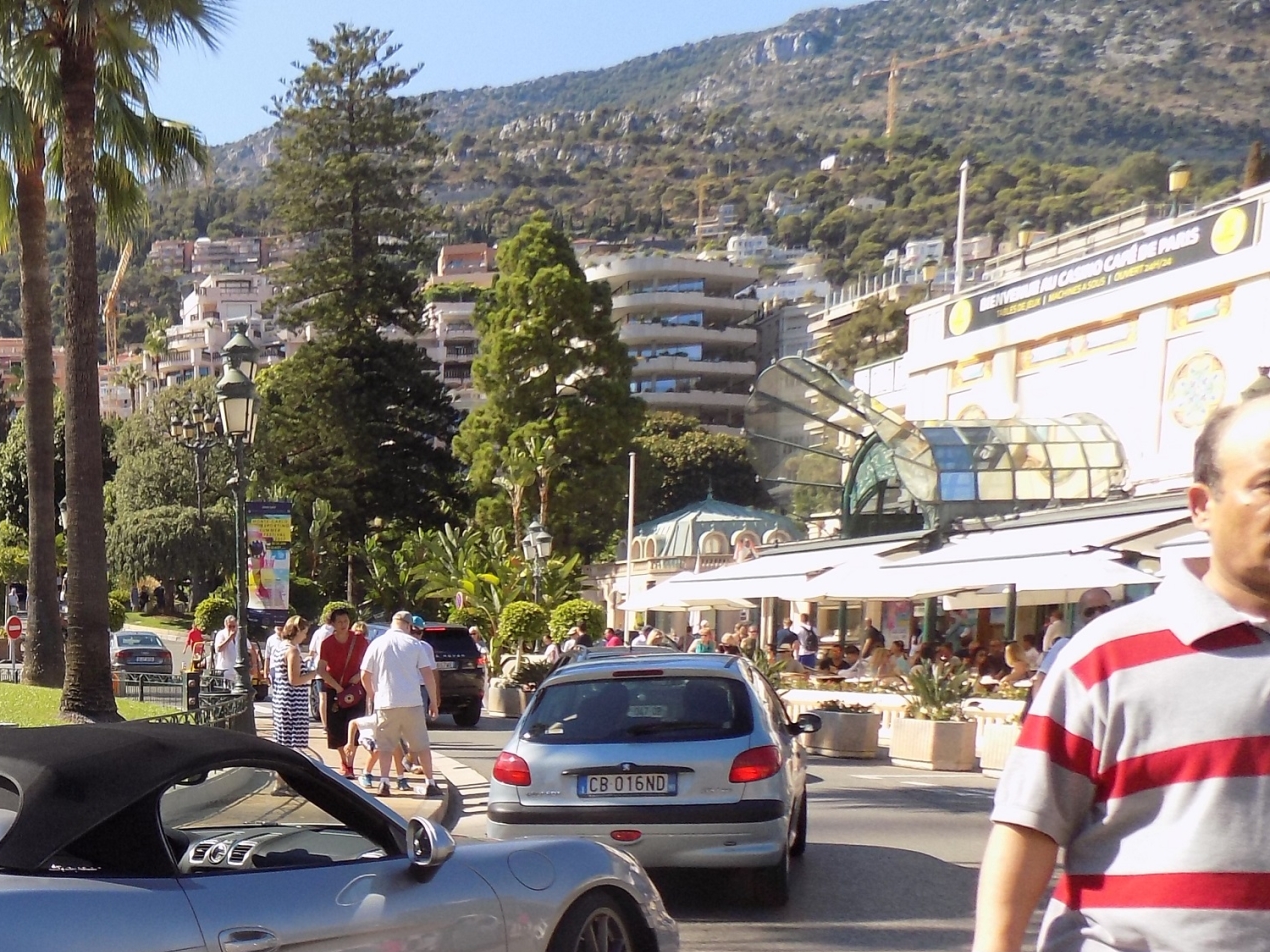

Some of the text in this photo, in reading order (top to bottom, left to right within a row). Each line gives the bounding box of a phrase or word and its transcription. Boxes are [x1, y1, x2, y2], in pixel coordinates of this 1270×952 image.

[979, 226, 1200, 312] BIENVENUE AU CASINO CAFÉ DE PARIS
[589, 775, 666, 792] CB 016ND
